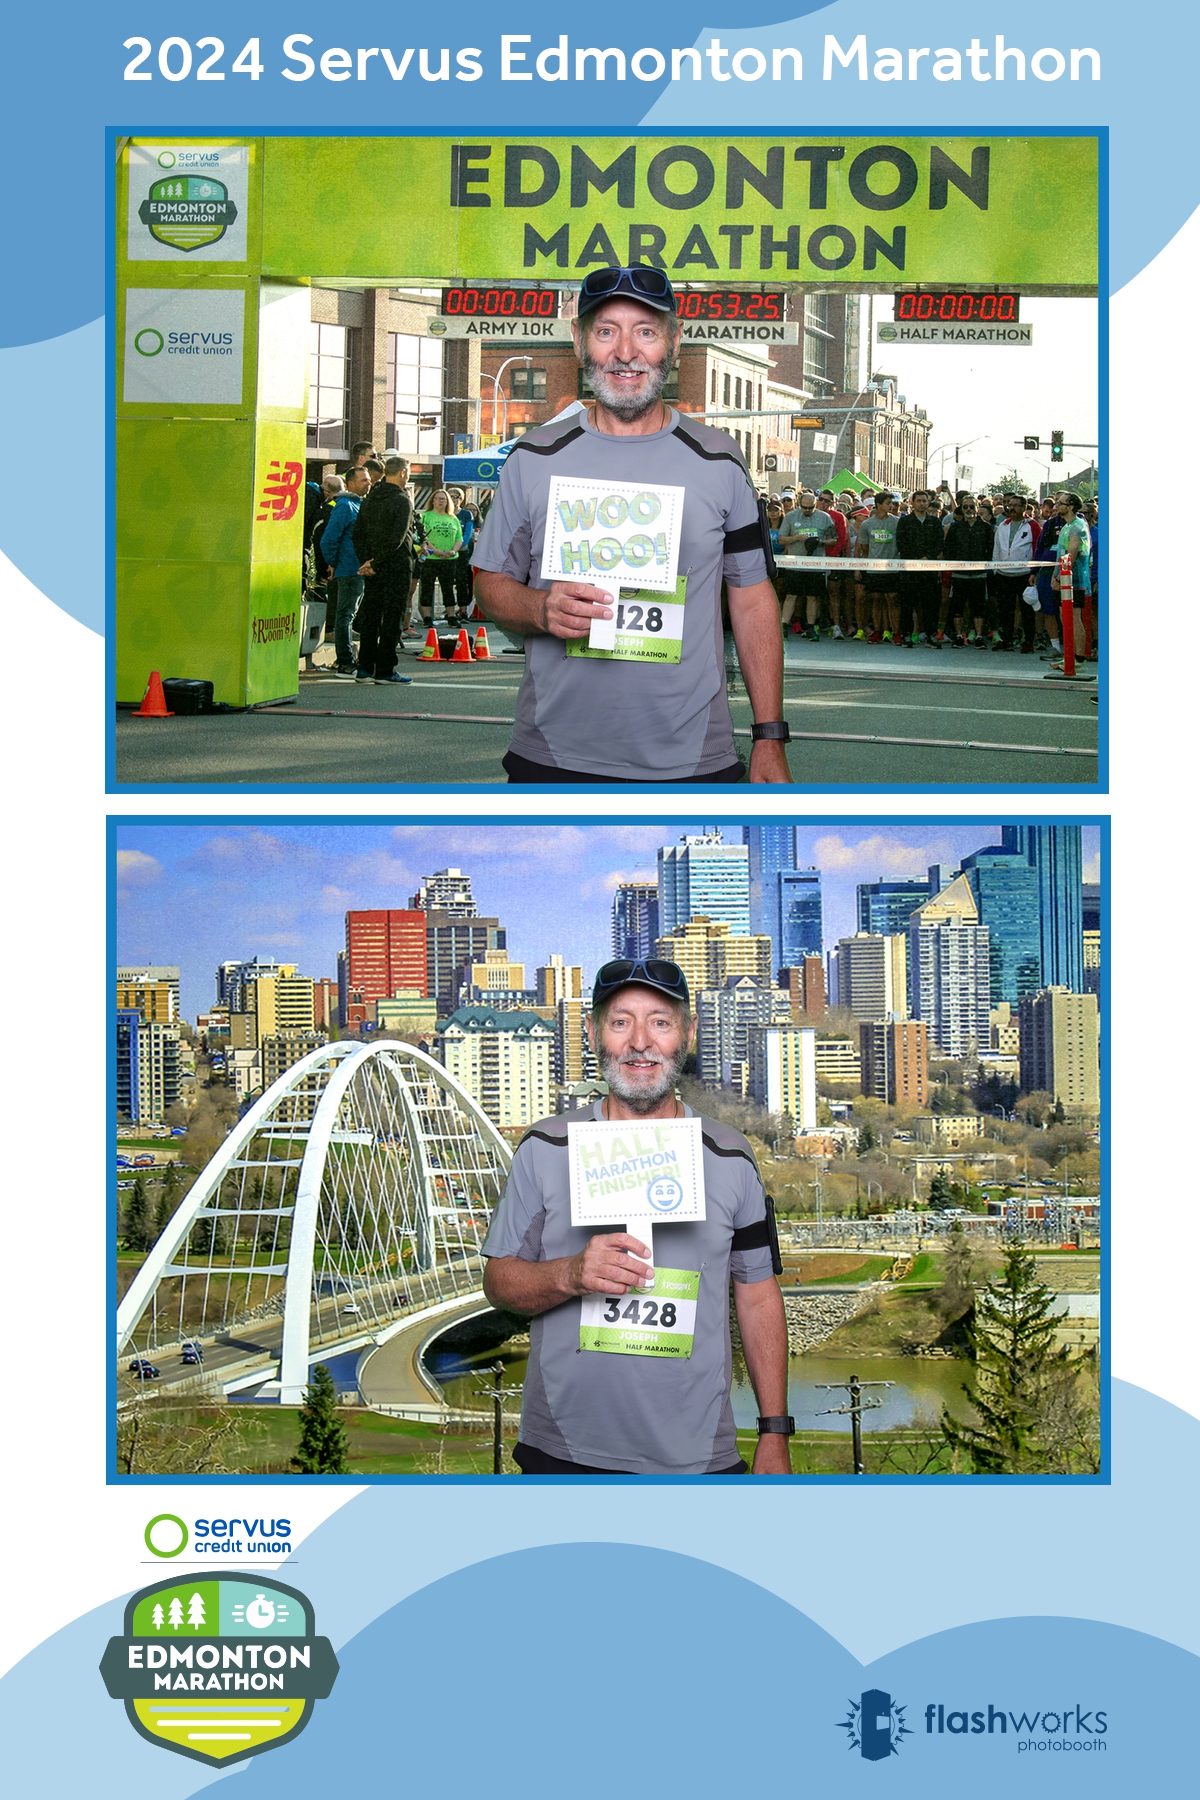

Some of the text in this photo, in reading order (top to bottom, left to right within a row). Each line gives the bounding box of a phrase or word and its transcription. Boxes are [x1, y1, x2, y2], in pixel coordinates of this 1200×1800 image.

[178, 152, 220, 161] servus
[451, 145, 991, 211] EDMONTON
[149, 203, 227, 213] EDMONTON
[160, 214, 215, 222] MARATHON
[523, 223, 907, 271] MARATHON
[465, 321, 555, 336] ARMY 10K
[682, 326, 785, 340] MARATHON
[900, 328, 1031, 341] HALF MARATHON
[168, 332, 233, 345] servus
[168, 345, 233, 355] credit union
[557, 491, 662, 532] WOO
[560, 532, 669, 574] HOO!
[257, 613, 291, 636] Running
[630, 650, 668, 659] MARATHON
[579, 1125, 671, 1169] HALF
[585, 1149, 677, 1182] MARATHON
[587, 1163, 682, 1198] FINISHER!
[603, 1297, 677, 1328] 3428
[619, 1331, 659, 1343] JOSEPH
[644, 1345, 680, 1353] MARATHON
